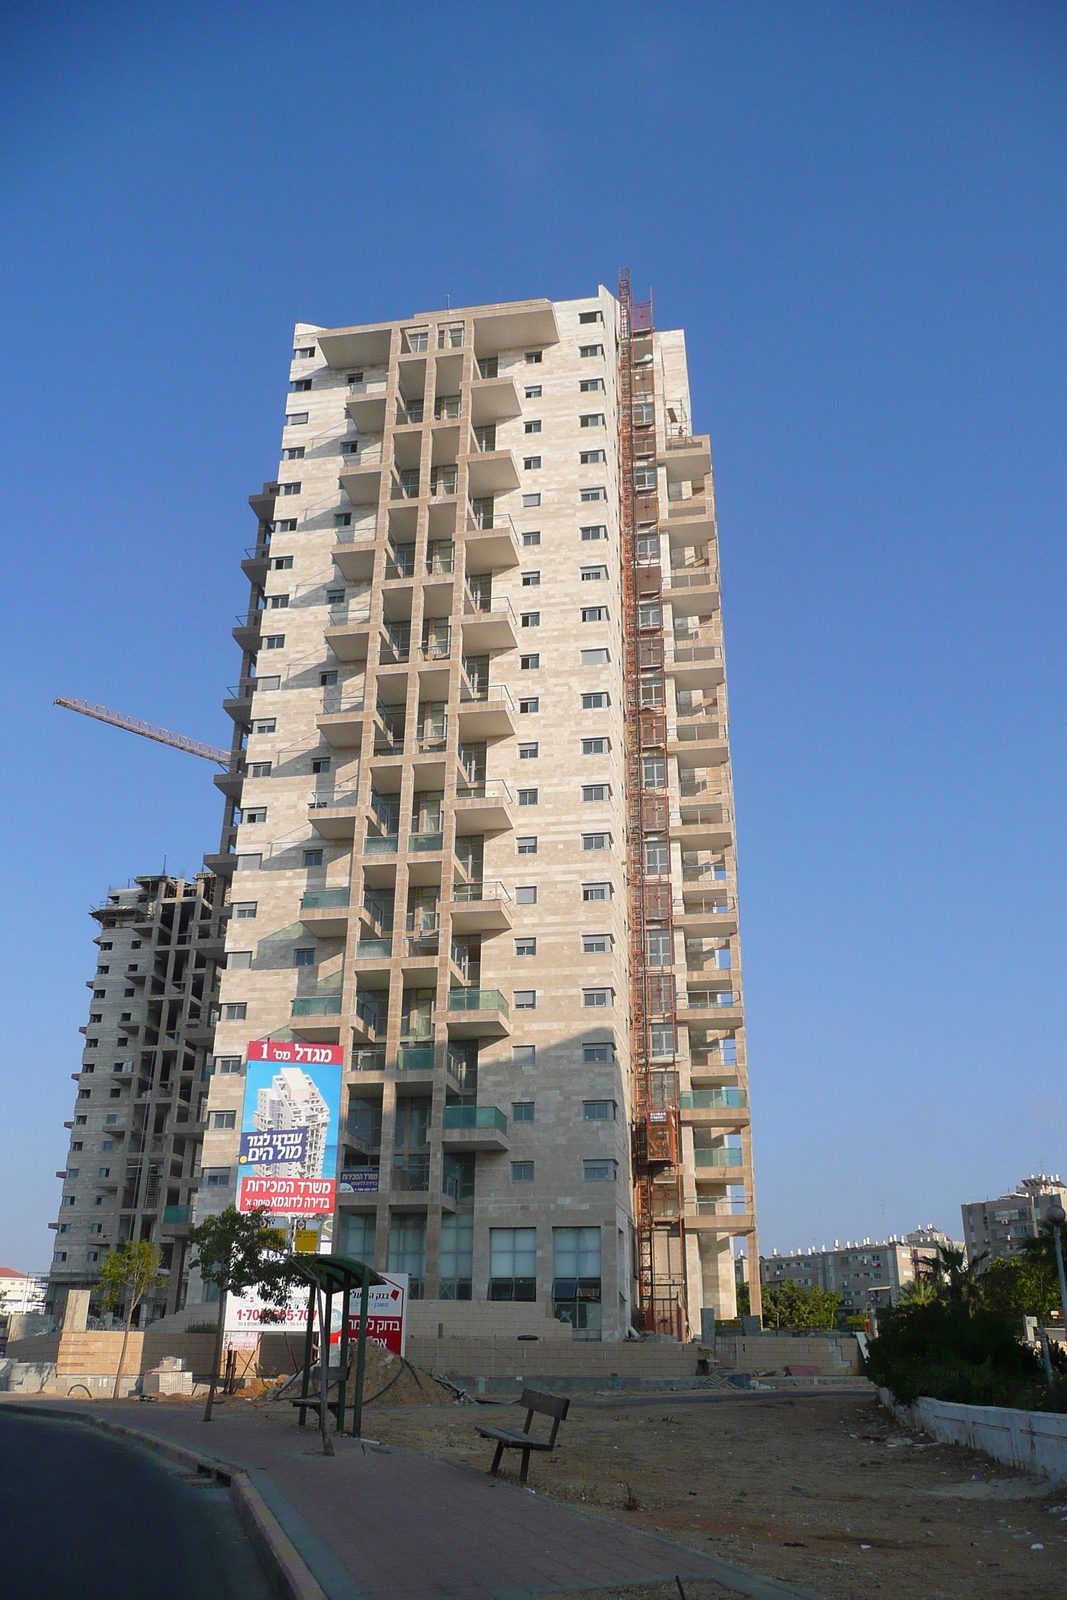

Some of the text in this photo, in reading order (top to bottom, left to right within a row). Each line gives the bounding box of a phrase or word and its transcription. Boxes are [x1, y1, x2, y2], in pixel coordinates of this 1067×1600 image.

[260, 1043, 268, 1059] 1
[294, 1044, 332, 1063] מגדל
[246, 1132, 303, 1147] עברנו לגור
[277, 1143, 302, 1160] מול
[246, 1179, 331, 1194] משרד המכירות
[271, 1195, 303, 1208] לדוגמא
[304, 1196, 330, 1209] בדירה
[376, 1292, 389, 1300] בנק
[376, 1320, 400, 1334] בדוק
